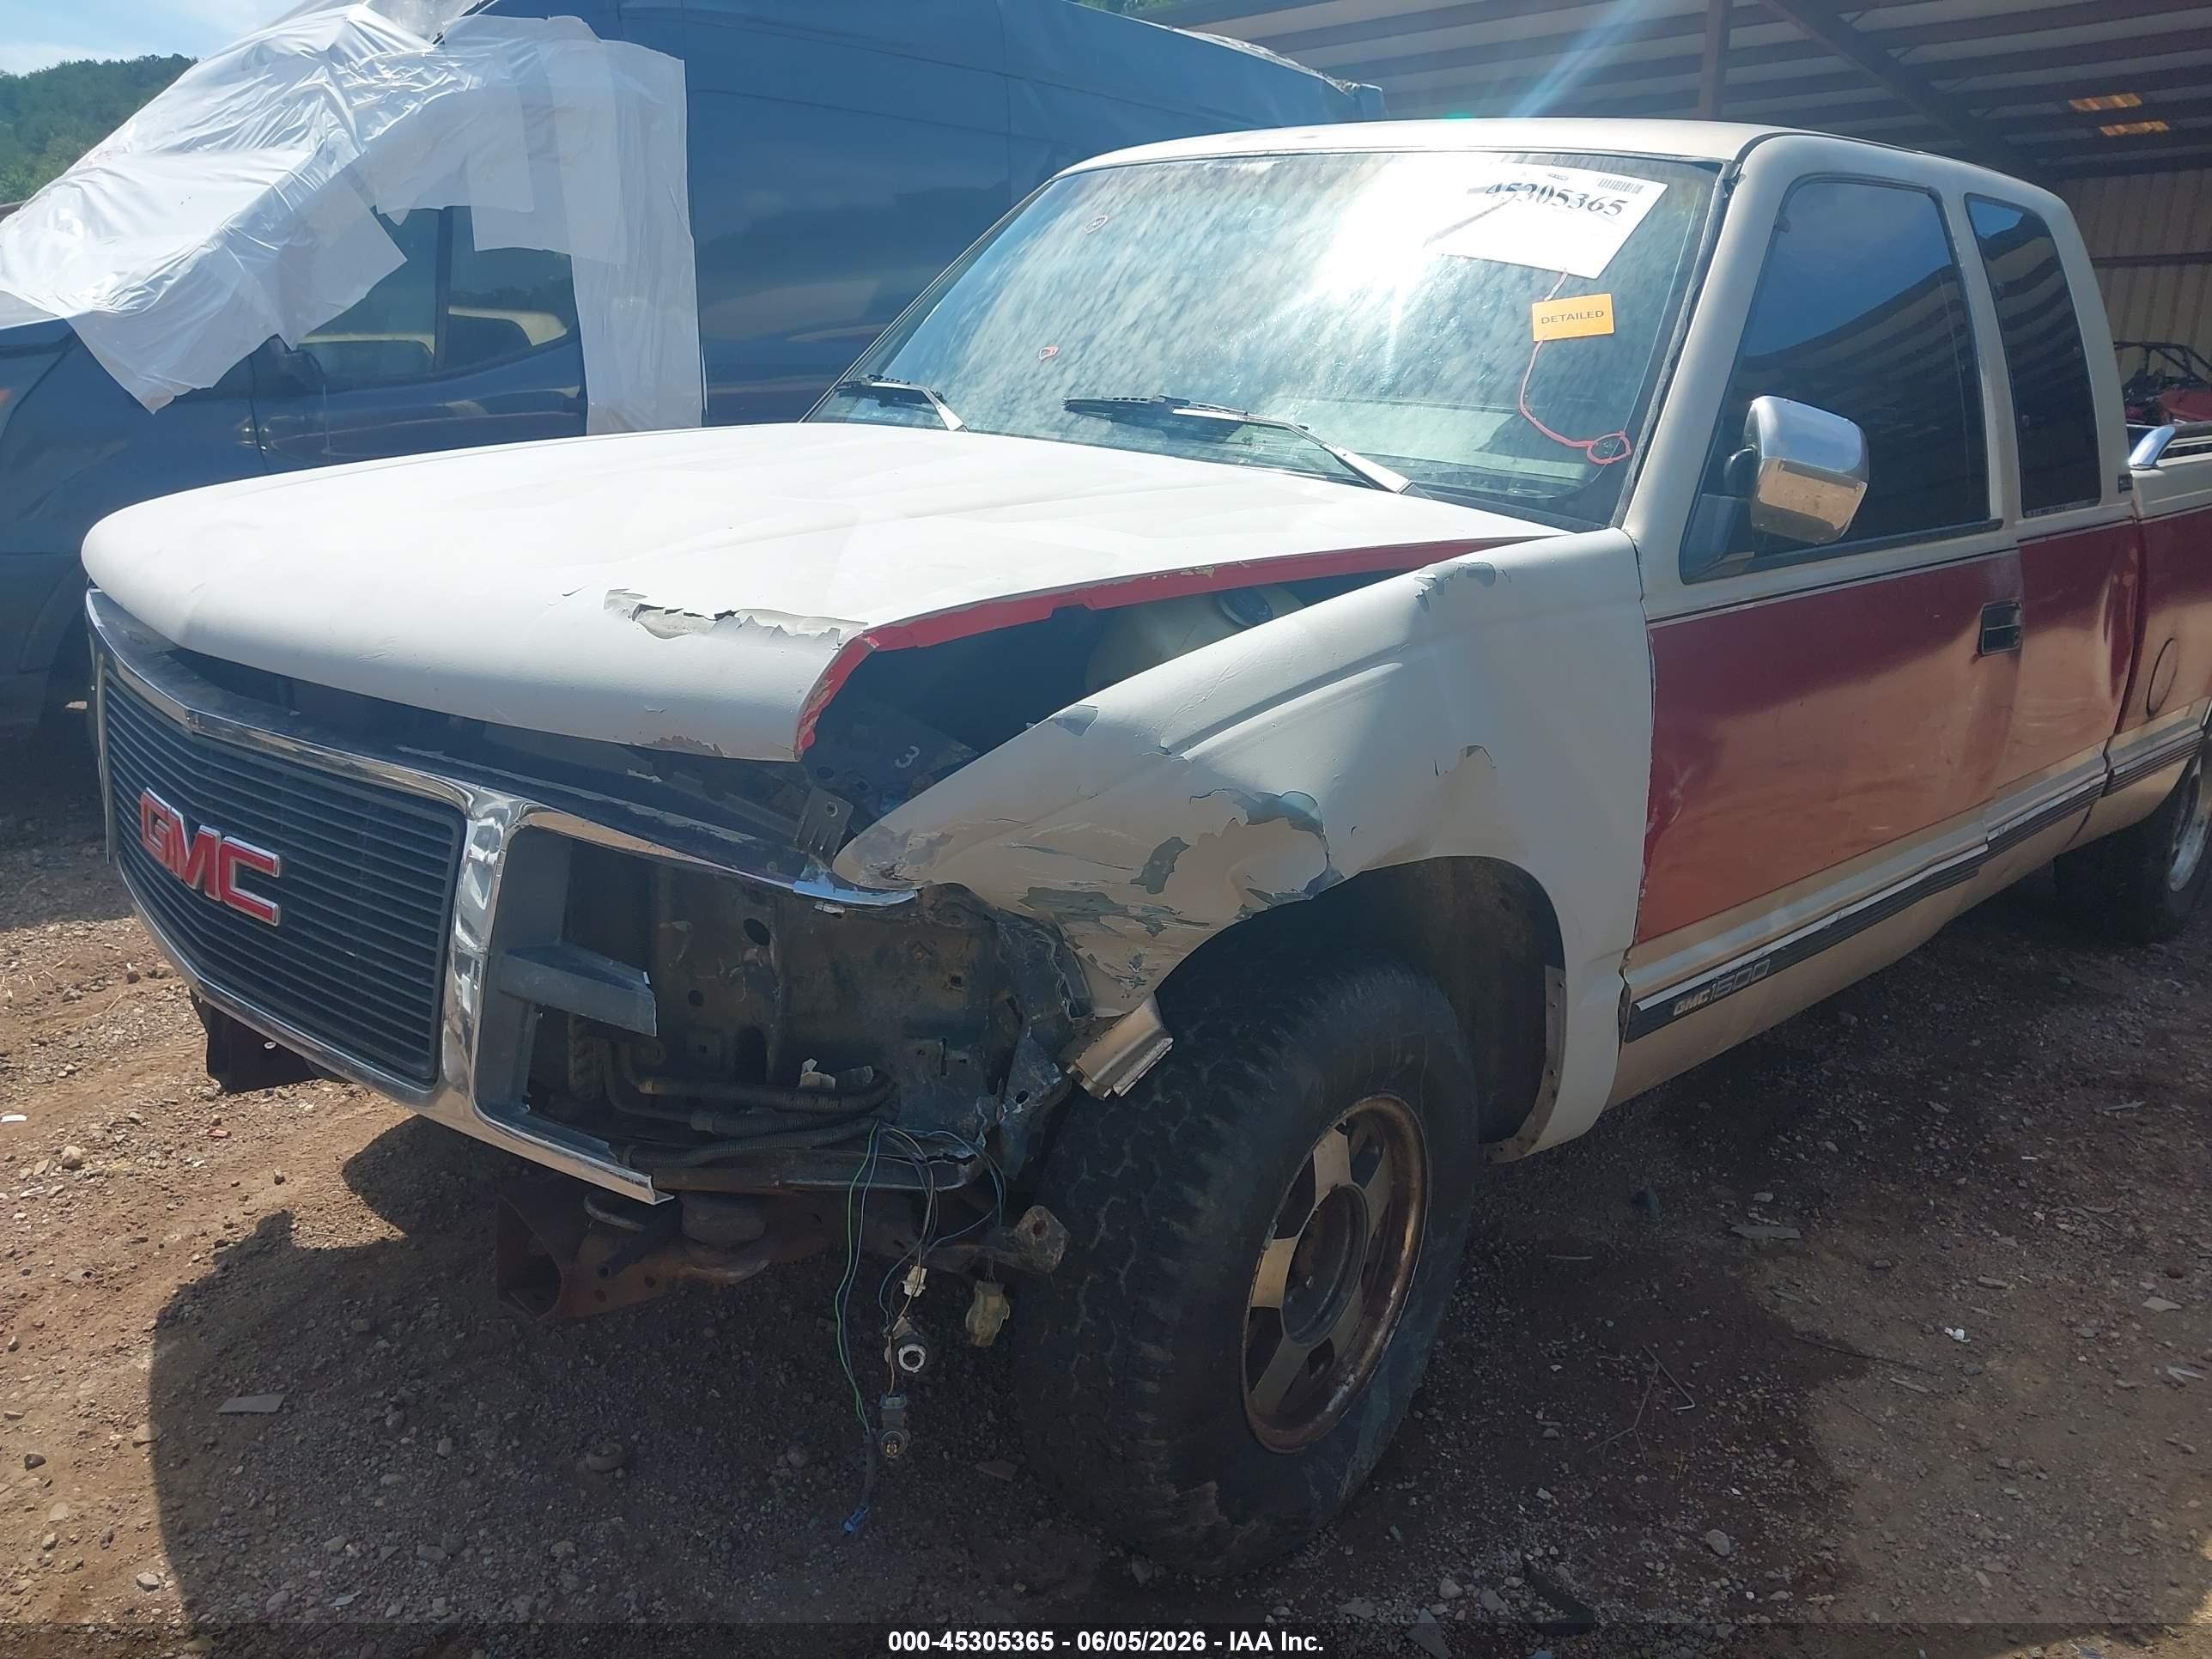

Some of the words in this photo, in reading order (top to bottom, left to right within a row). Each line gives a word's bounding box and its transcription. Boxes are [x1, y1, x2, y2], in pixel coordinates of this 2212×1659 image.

[1485, 183, 1629, 216] 45305365
[1540, 309, 1605, 324] DETAILED
[140, 787, 281, 927] GMC
[1673, 988, 1712, 1017] GMC
